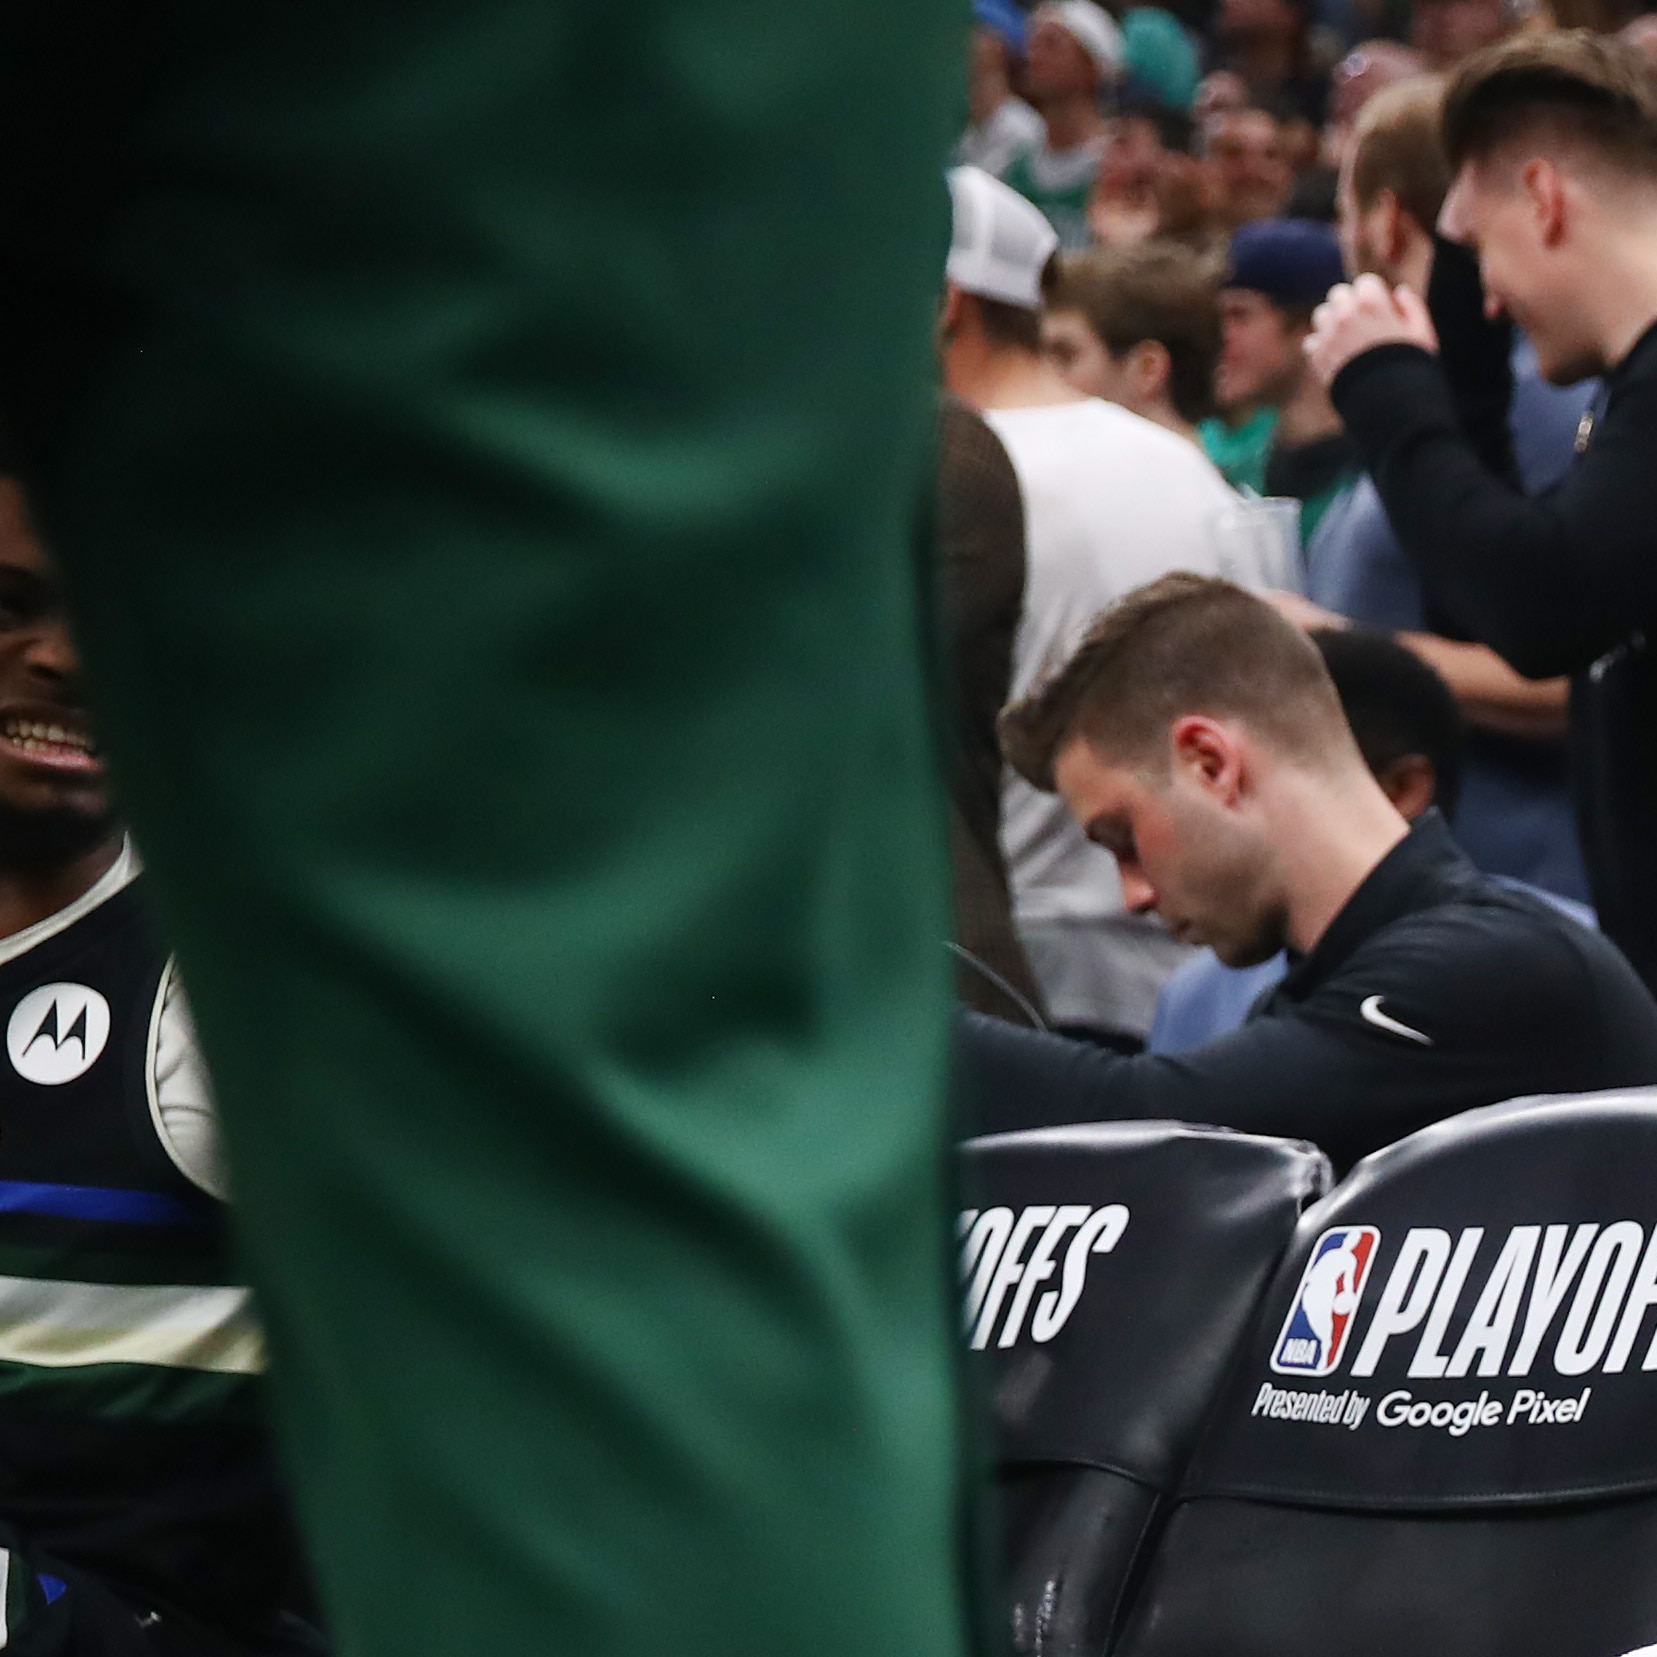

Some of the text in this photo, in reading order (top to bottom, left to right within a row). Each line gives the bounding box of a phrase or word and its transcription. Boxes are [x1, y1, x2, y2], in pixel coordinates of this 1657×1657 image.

[1280, 1337, 1317, 1365] NBA
[1251, 1382, 1592, 1437] Presented by Google Pixel
